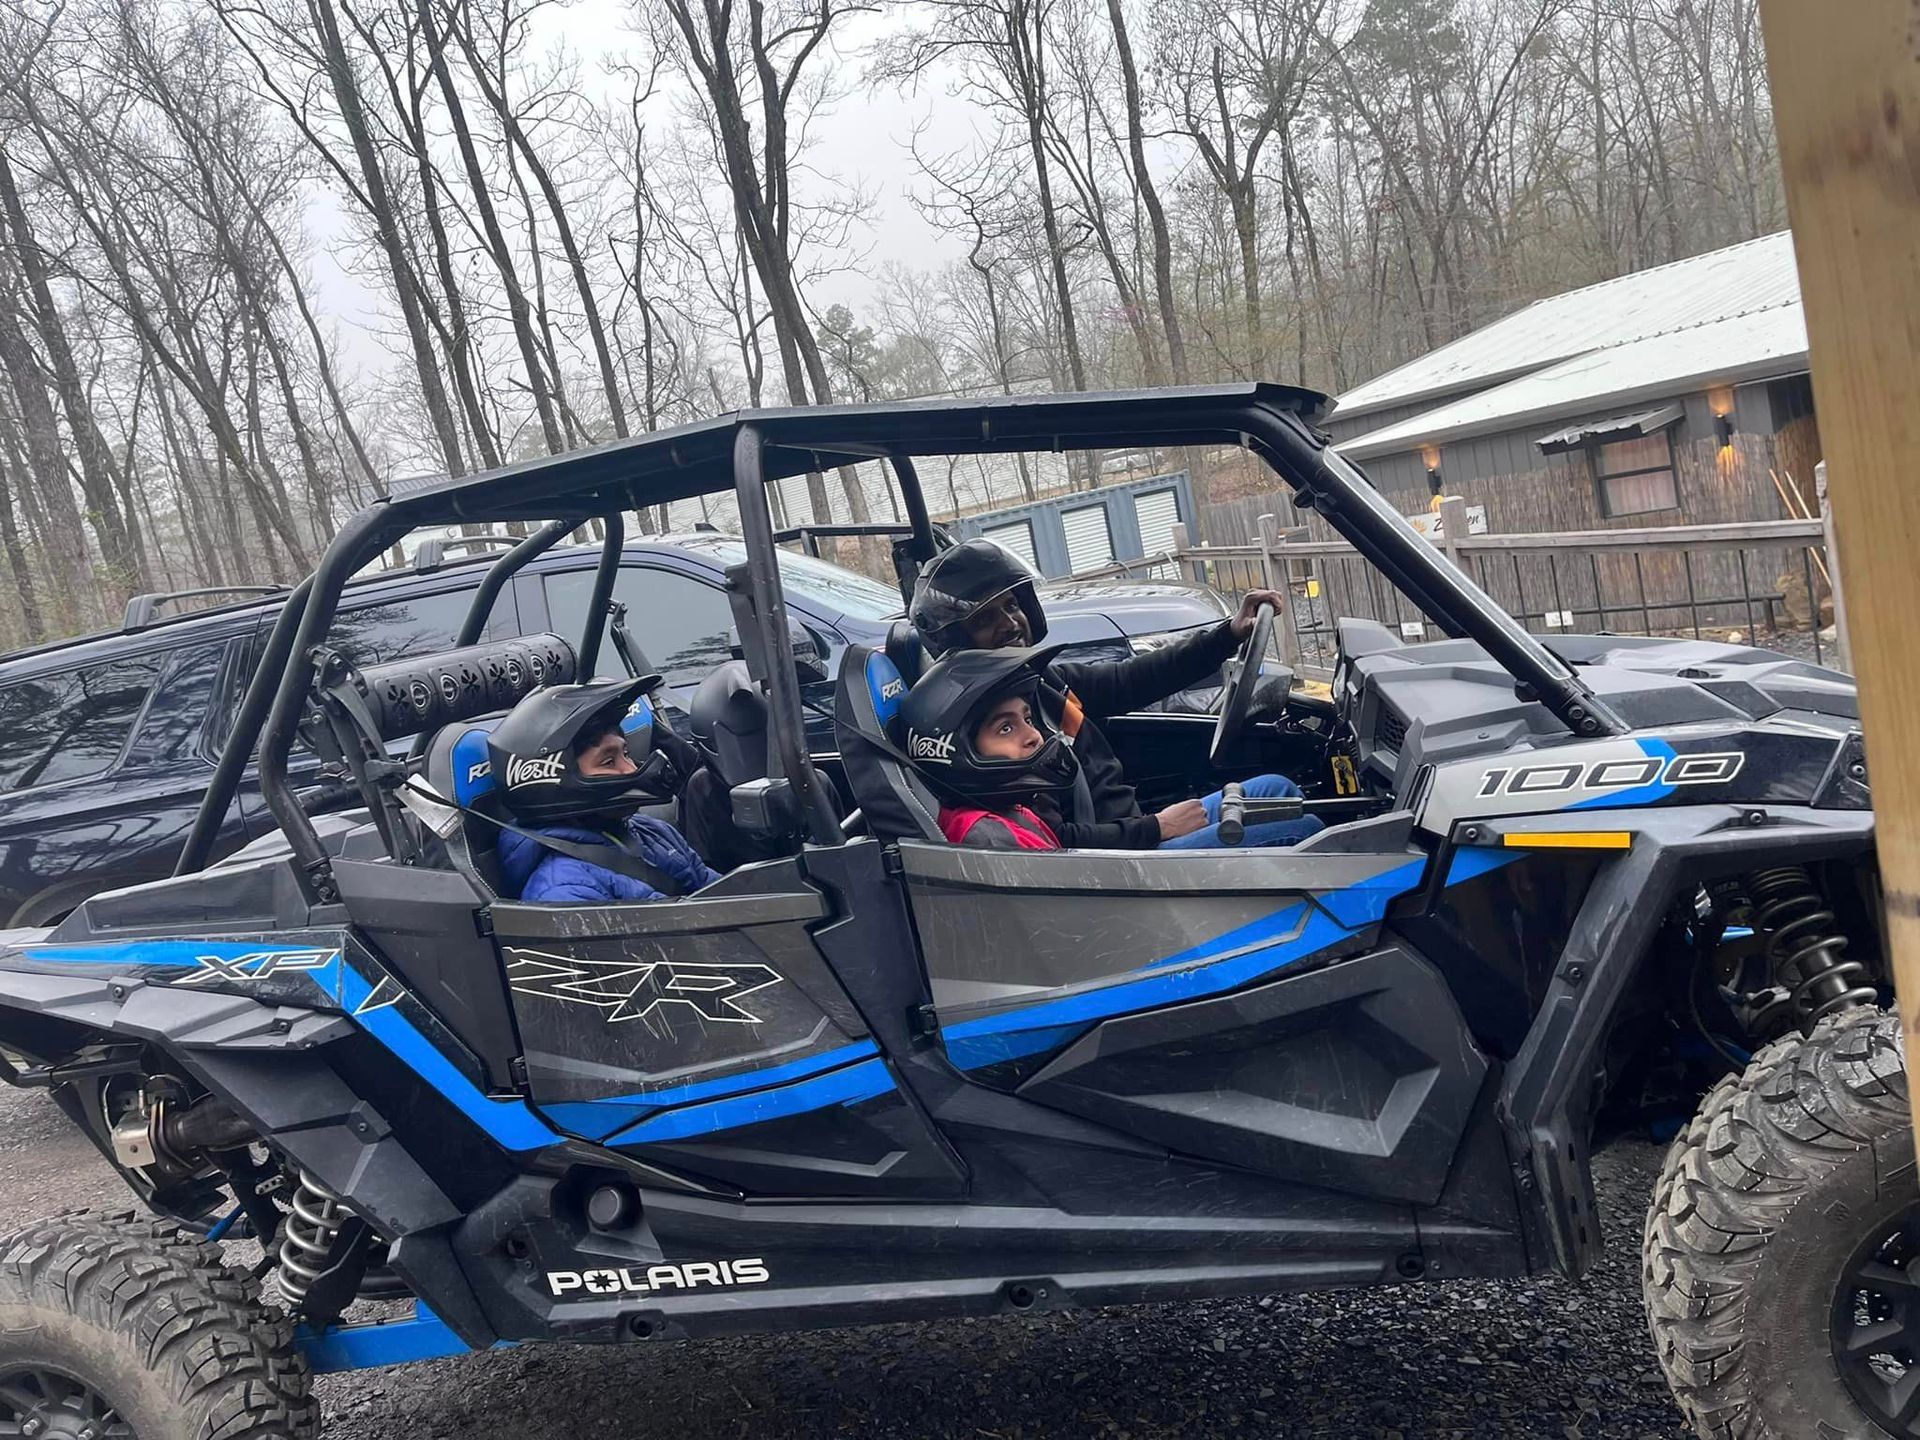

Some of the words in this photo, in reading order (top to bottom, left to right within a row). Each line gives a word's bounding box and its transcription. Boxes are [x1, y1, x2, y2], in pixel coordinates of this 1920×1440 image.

[882, 678, 904, 702] RZR
[907, 727, 956, 764] Westt
[468, 760, 492, 784] RZ
[506, 751, 566, 791] Westt
[1475, 751, 1745, 799] 1000
[170, 948, 342, 985] XP
[547, 1257, 770, 1296] POLARIS
